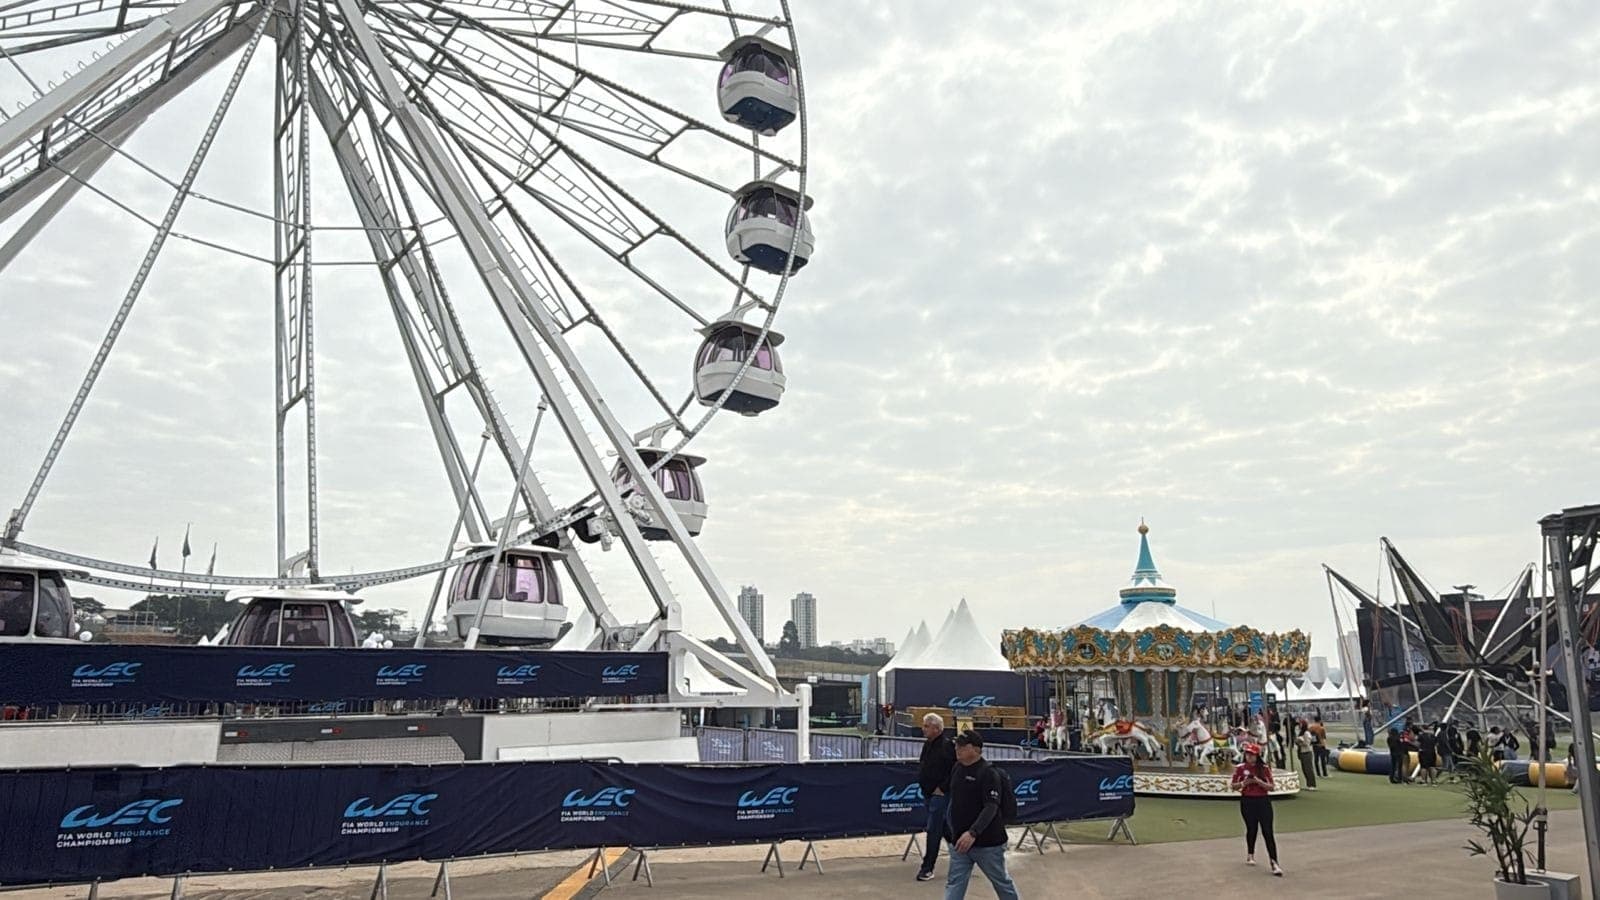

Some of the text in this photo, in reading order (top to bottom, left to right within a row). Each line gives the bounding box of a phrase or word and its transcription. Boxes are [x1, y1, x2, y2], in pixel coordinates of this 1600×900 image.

[73, 662, 142, 676] WEC
[237, 663, 296, 677] WEC
[377, 664, 427, 676] WEC
[497, 664, 541, 676] WEC
[602, 664, 640, 676] WEC
[949, 695, 995, 707] WEC
[562, 787, 636, 807] WEC
[738, 786, 799, 807] WEC
[343, 793, 439, 818] WEC
[60, 798, 183, 828] WEC
[57, 829, 171, 841] FIA WORLD ENDURANCE
[341, 827, 399, 835] CHAMPIONSHIP
[56, 838, 132, 848] CHAMPIONSHIP
